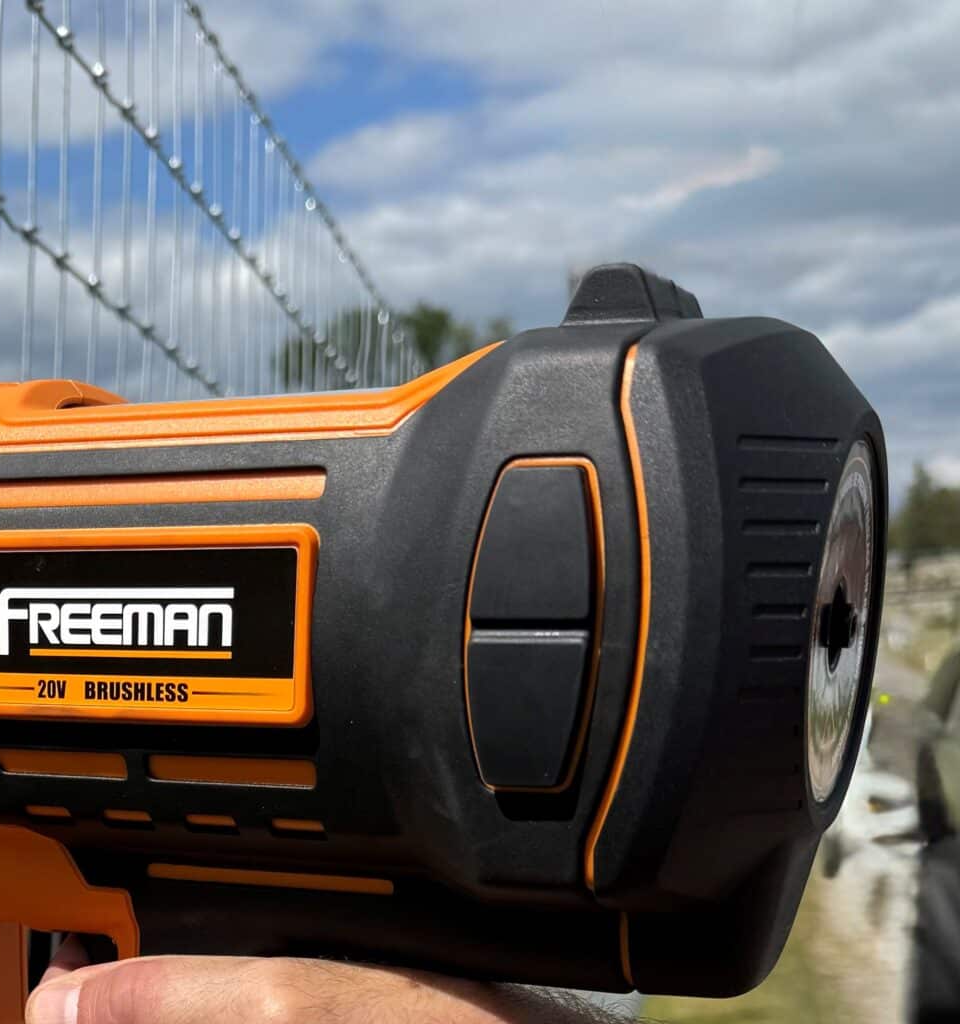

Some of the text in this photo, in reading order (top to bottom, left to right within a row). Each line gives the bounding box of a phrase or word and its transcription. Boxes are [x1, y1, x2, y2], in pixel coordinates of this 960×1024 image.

[0, 587, 234, 655] FREEMAN
[38, 680, 188, 702] 20V BRUSHLESS
